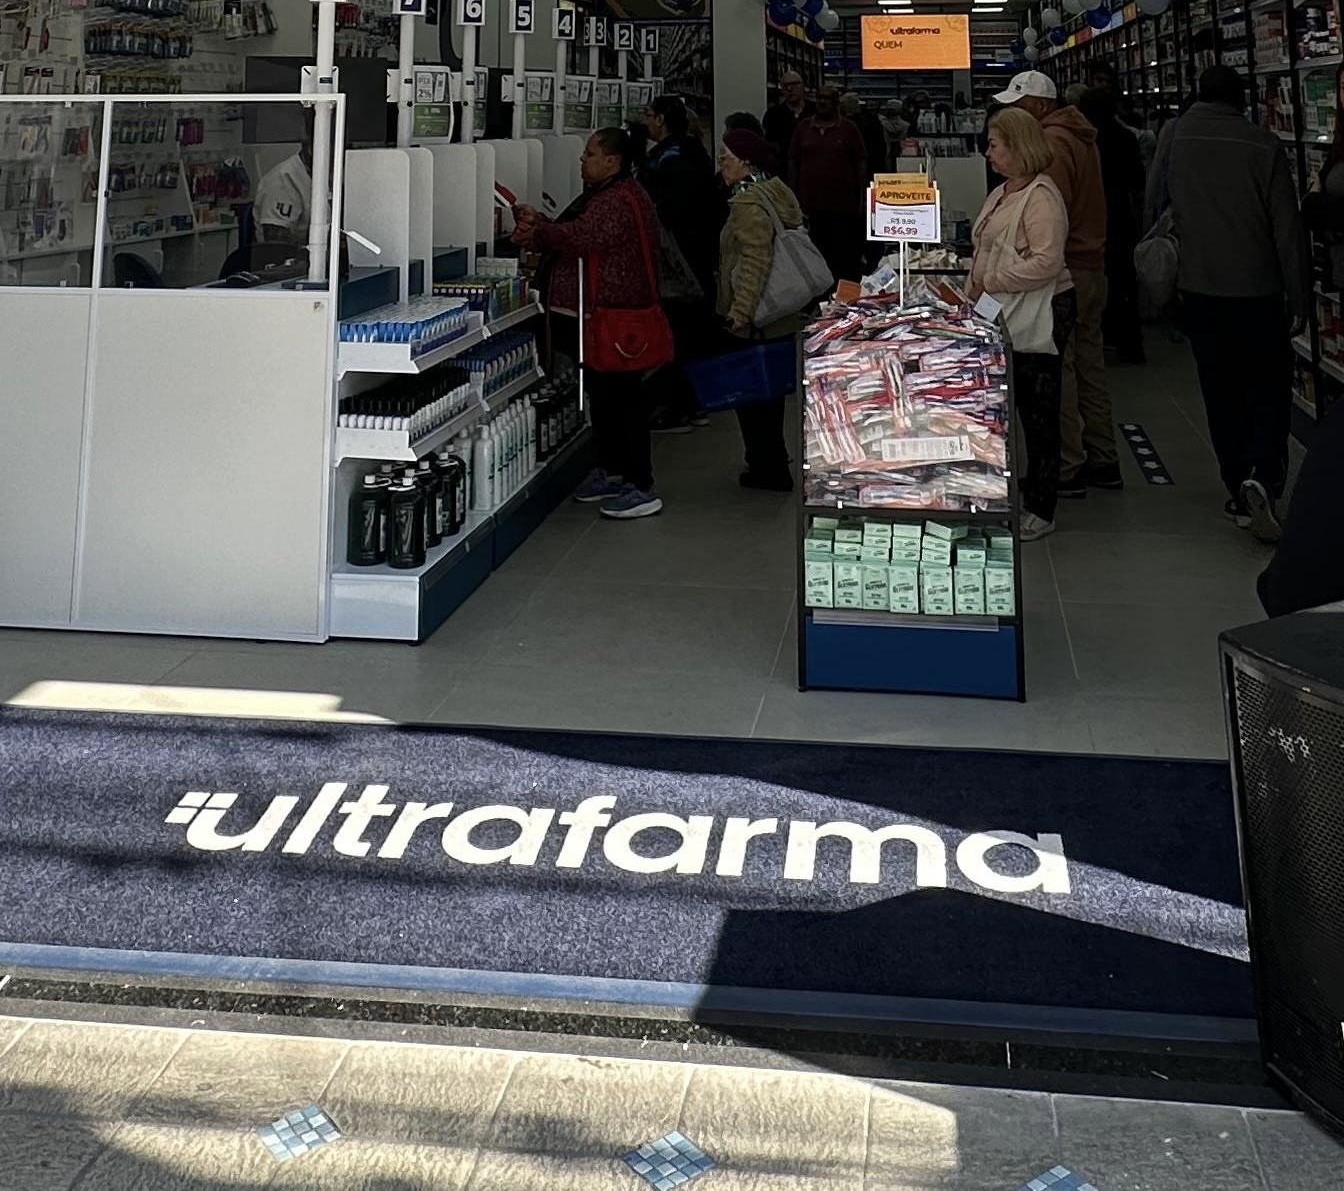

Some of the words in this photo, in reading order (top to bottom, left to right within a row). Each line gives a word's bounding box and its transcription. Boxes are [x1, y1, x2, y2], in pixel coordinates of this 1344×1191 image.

[518, 6, 530, 26] 5
[558, 15, 571, 33] 4
[596, 21, 604, 40] 3
[619, 28, 630, 45] 2
[646, 29, 655, 48] 1
[890, 26, 941, 36] ultrafarma
[873, 40, 903, 50] QUEM
[879, 191, 932, 201] APROVEITE
[165, 782, 1071, 895] ultrafarma
